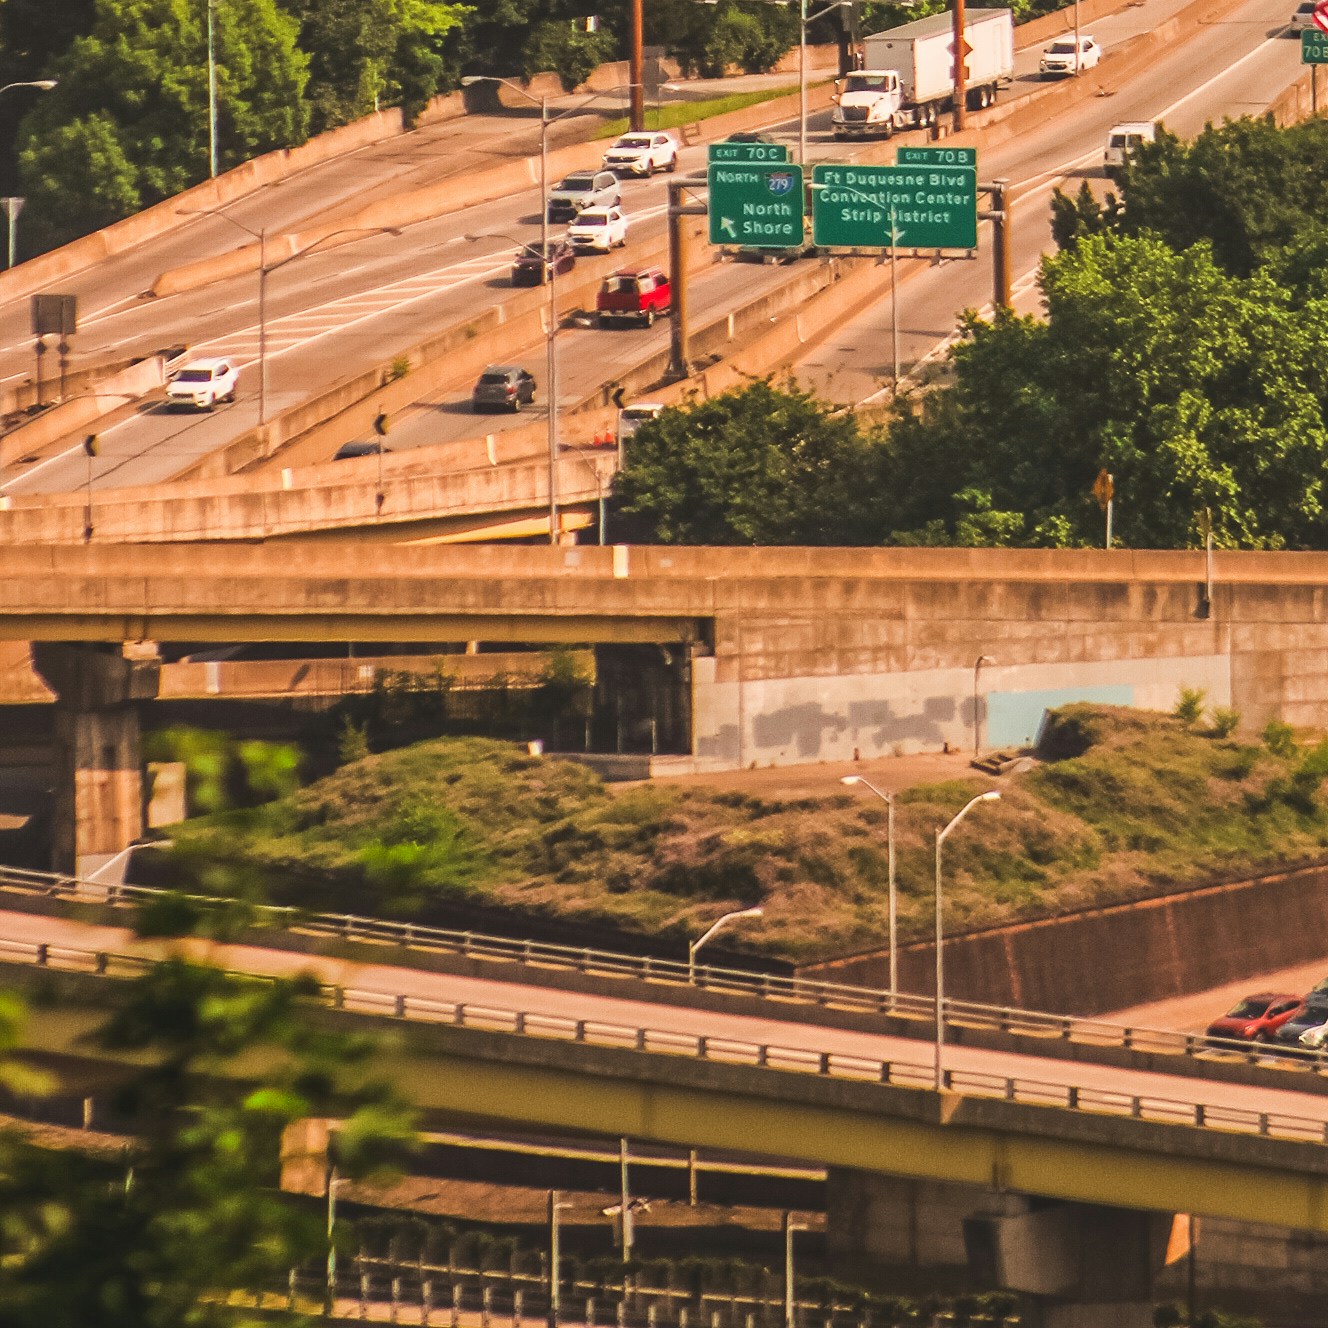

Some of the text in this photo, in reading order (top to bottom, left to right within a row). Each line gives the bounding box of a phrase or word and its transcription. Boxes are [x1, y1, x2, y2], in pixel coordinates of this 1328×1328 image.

[716, 149, 738, 158] EXIT
[905, 151, 928, 160] EXIT
[716, 170, 788, 191] NORTH 279
[824, 172, 966, 187] Ft Duquesne Blvd
[820, 190, 970, 205] Convention Center
[743, 203, 792, 216] North
[841, 209, 883, 223] Strip
[743, 222, 793, 235] Shore
